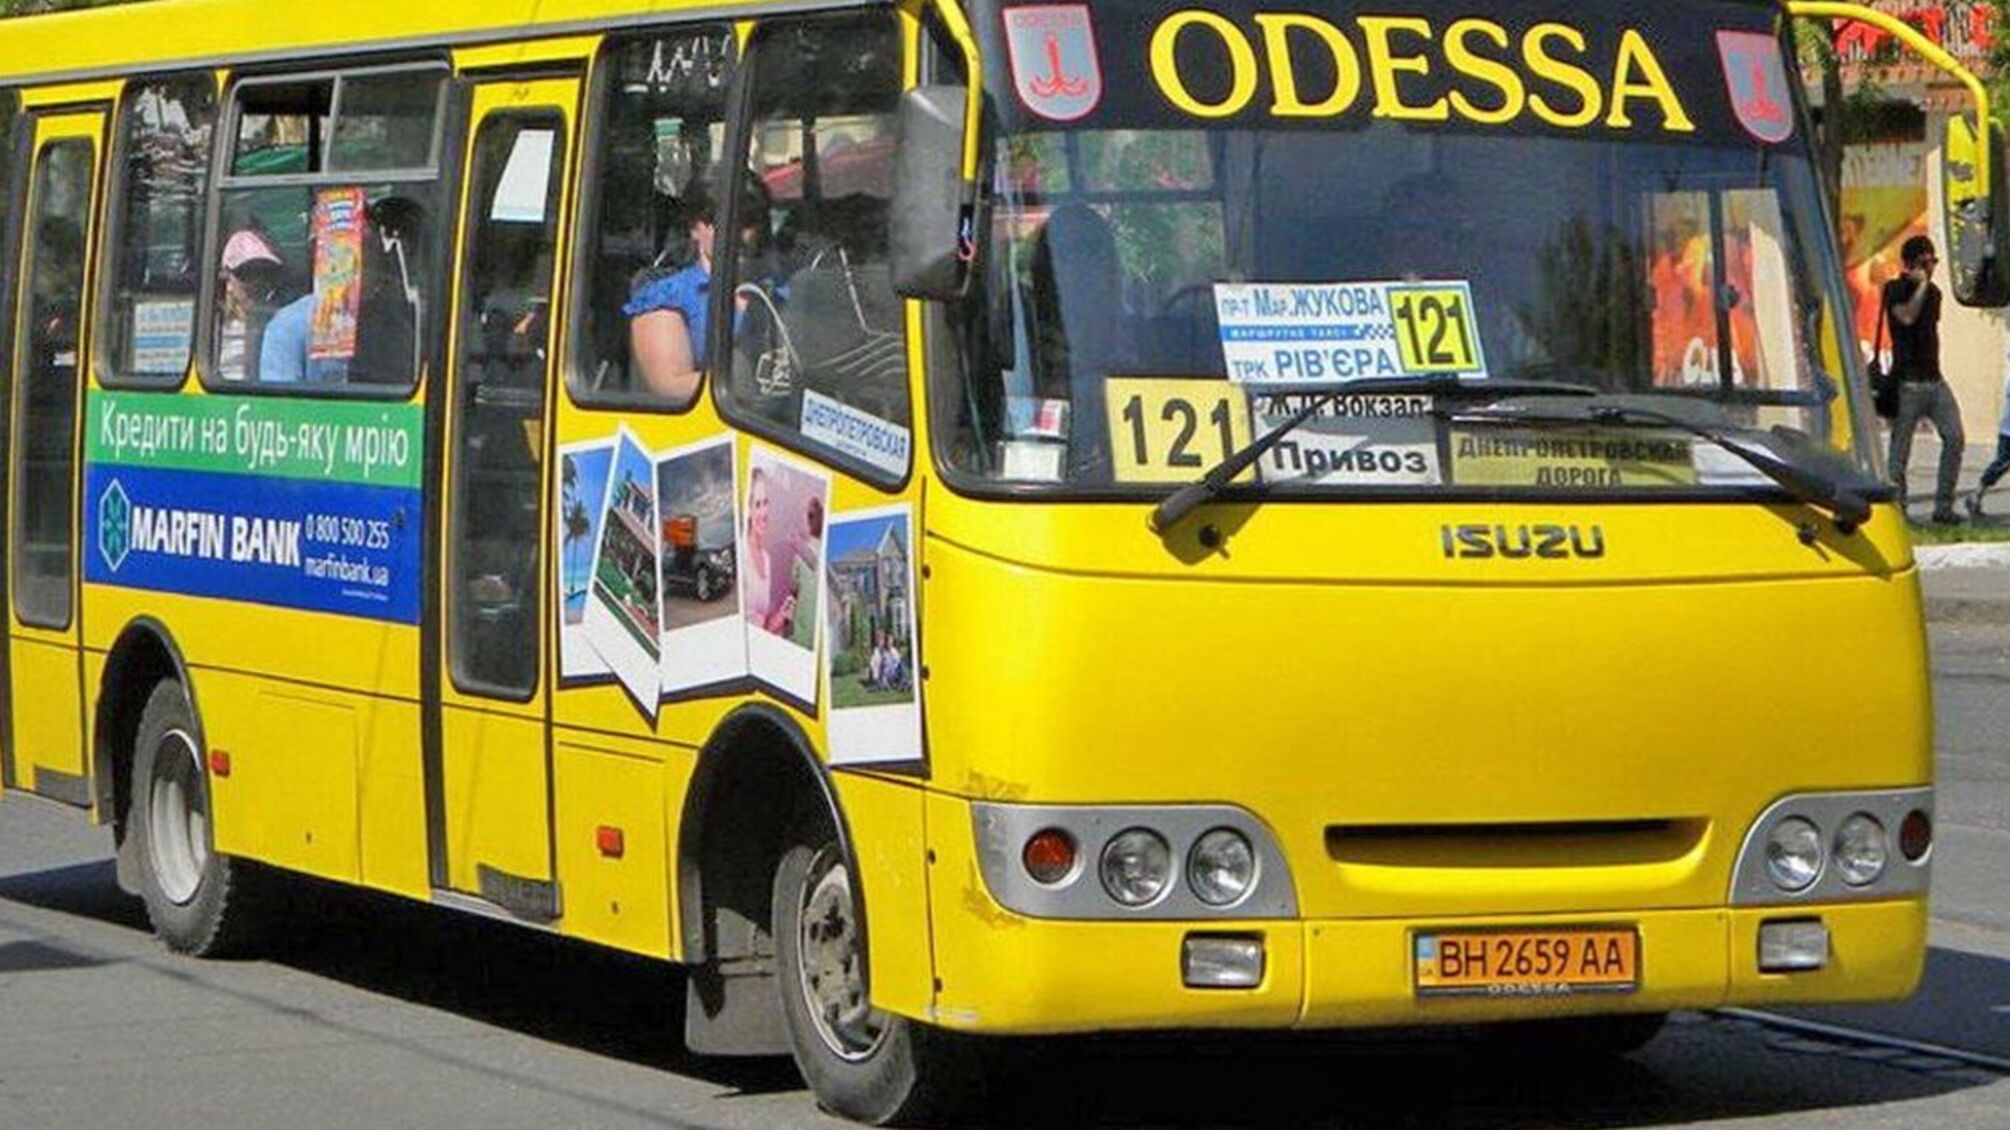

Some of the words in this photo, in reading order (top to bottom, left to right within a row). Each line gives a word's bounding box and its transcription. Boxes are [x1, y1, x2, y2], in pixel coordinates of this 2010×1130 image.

[1150, 10, 1695, 132] ODESSA
[1397, 295, 1473, 365] 121
[1232, 361, 1268, 377] ТРК
[100, 401, 194, 459] Кредити
[201, 418, 228, 454] на
[235, 404, 339, 475] будь-яку
[345, 412, 409, 478] мрію
[1123, 394, 1236, 468] 121
[1272, 441, 1427, 477] Привоз
[1535, 465, 1623, 486] ДОРОГА
[131, 506, 226, 560] MARFIN
[231, 516, 301, 568] BANK
[305, 513, 314, 541] 0
[316, 514, 340, 544] 800
[341, 516, 365, 546] 500
[366, 519, 390, 549] 255
[1440, 524, 1605, 559] ISUZU
[304, 552, 389, 587] marfinbank.ua
[1439, 939, 1488, 978] BH
[1495, 938, 1571, 977] 2659
[1579, 937, 1625, 975] AA
